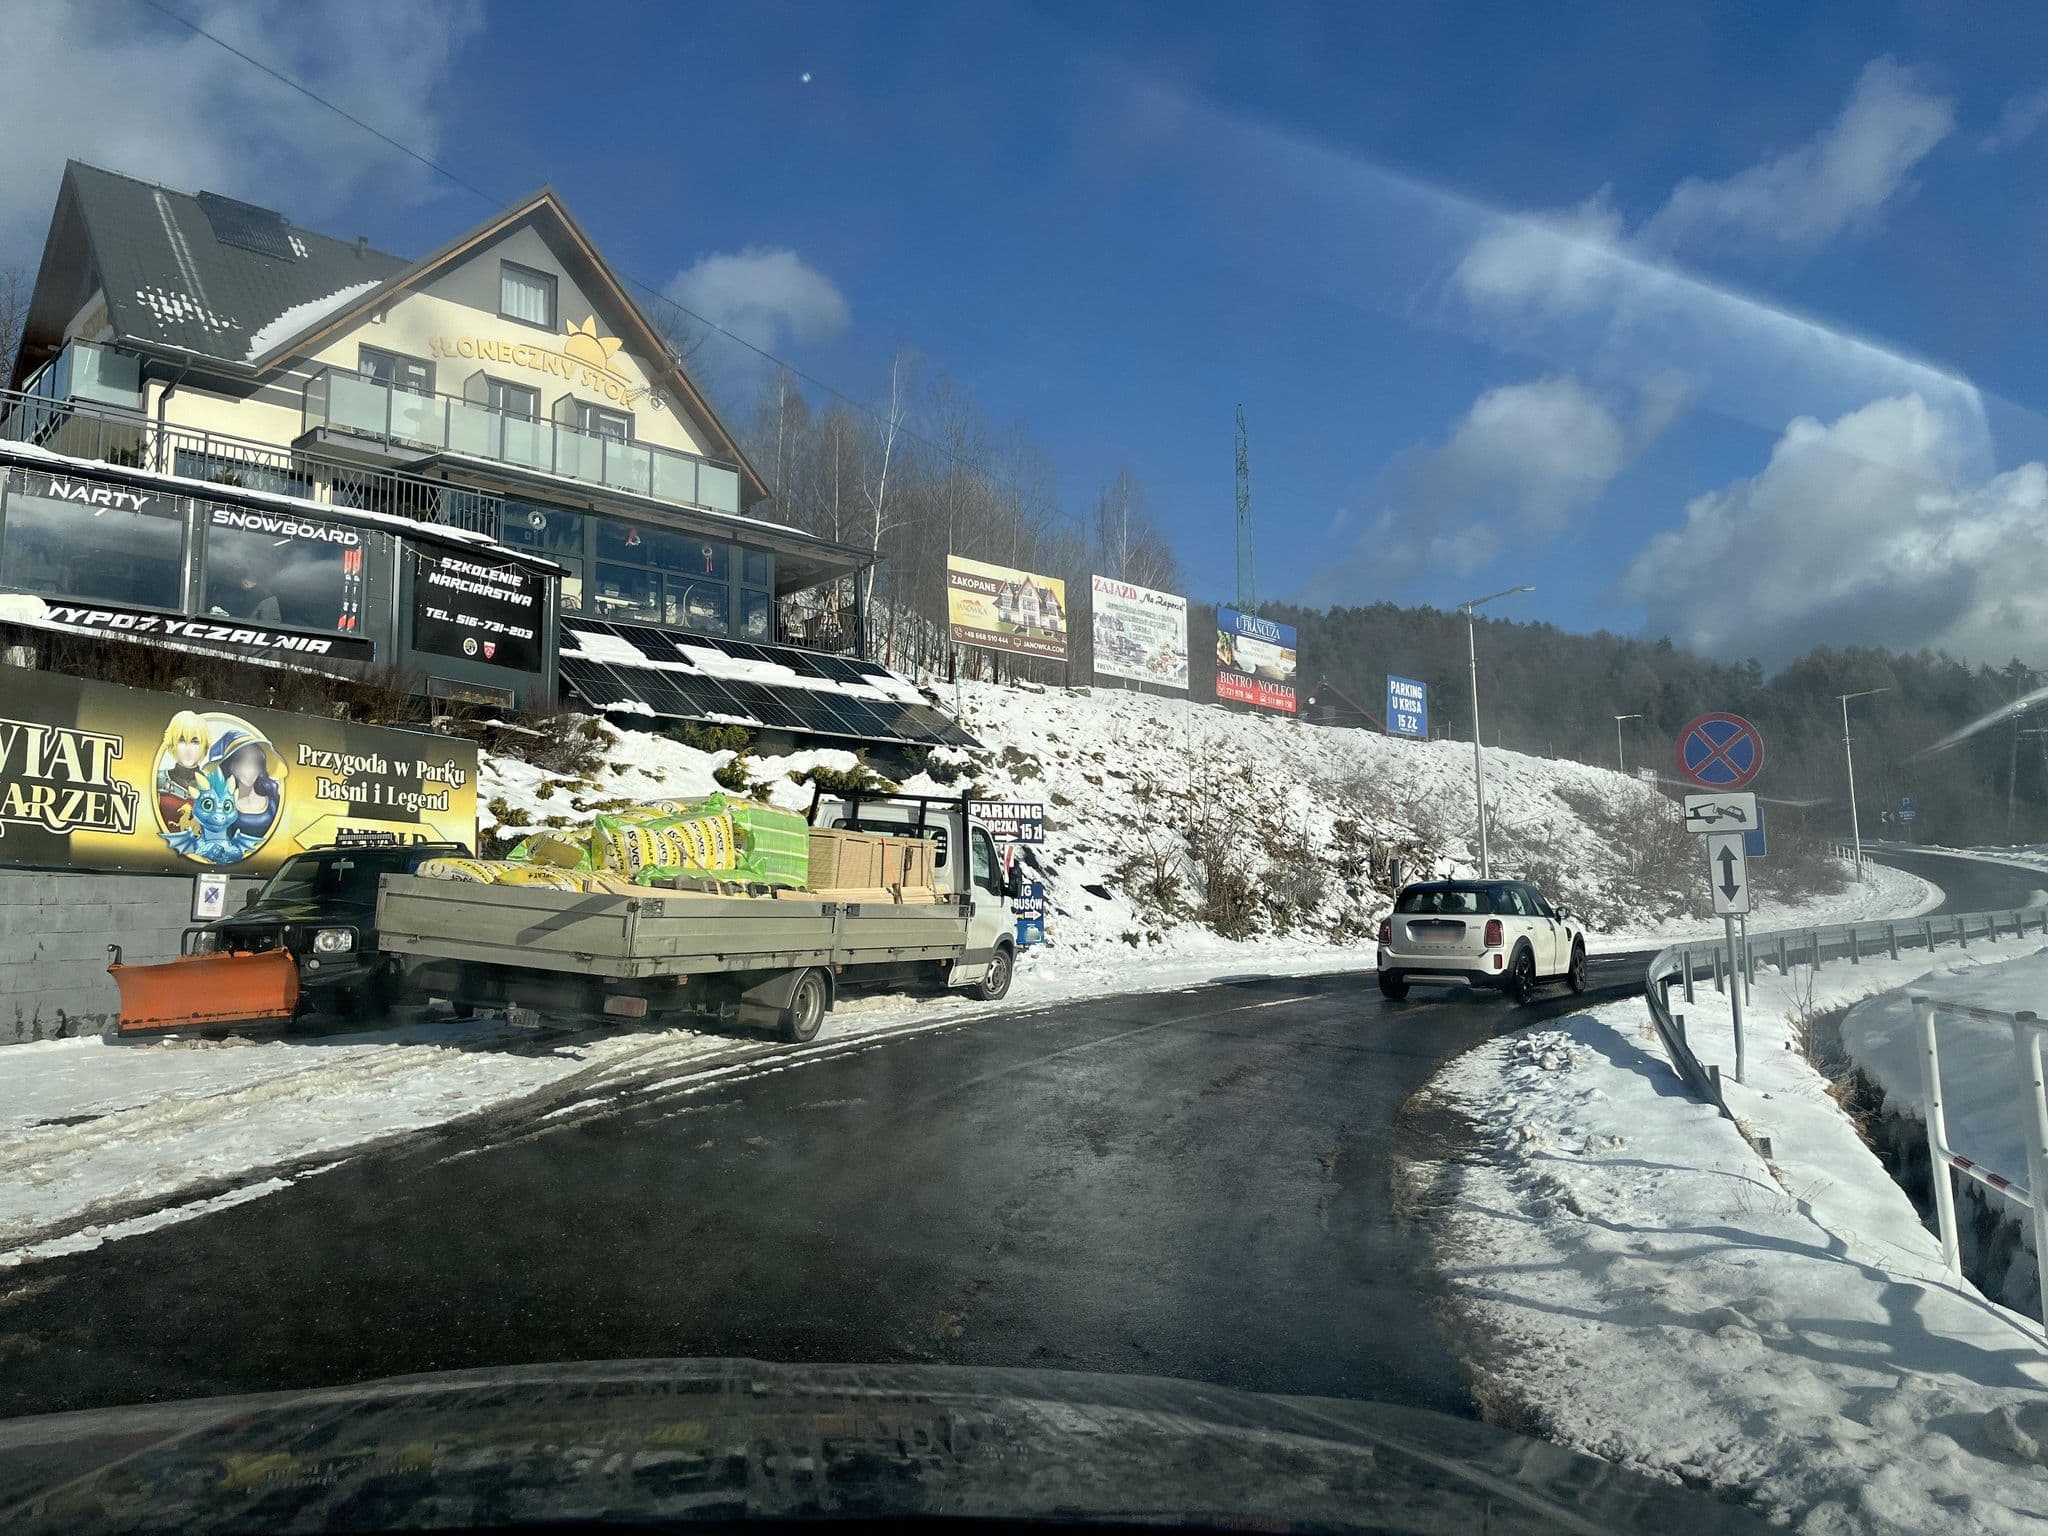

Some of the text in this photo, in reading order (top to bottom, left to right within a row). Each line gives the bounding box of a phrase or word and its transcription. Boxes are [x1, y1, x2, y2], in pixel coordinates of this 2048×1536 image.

[49, 481, 149, 511] NARTY
[212, 510, 360, 546] SNOWBOARD
[440, 556, 523, 587] SZKOLENIE
[428, 572, 533, 607] NARCIARSTWA
[951, 574, 996, 593] ZAKOPANE
[1094, 579, 1138, 600] ZAJAZD
[426, 606, 534, 640] TEL. 516-731-203
[1236, 617, 1242, 629] U
[1023, 640, 1065, 654] JANOWKA.COM
[1220, 671, 1295, 699] BISTRO NOCLEGI
[1391, 680, 1423, 700] PARKING
[1392, 696, 1422, 714] U KRISA
[1398, 714, 1406, 727] 15
[298, 743, 466, 789] Przygoda w Parku
[317, 777, 449, 813] Baśni i Legend
[970, 803, 1043, 820] PARKING
[1019, 823, 1032, 840] 15
